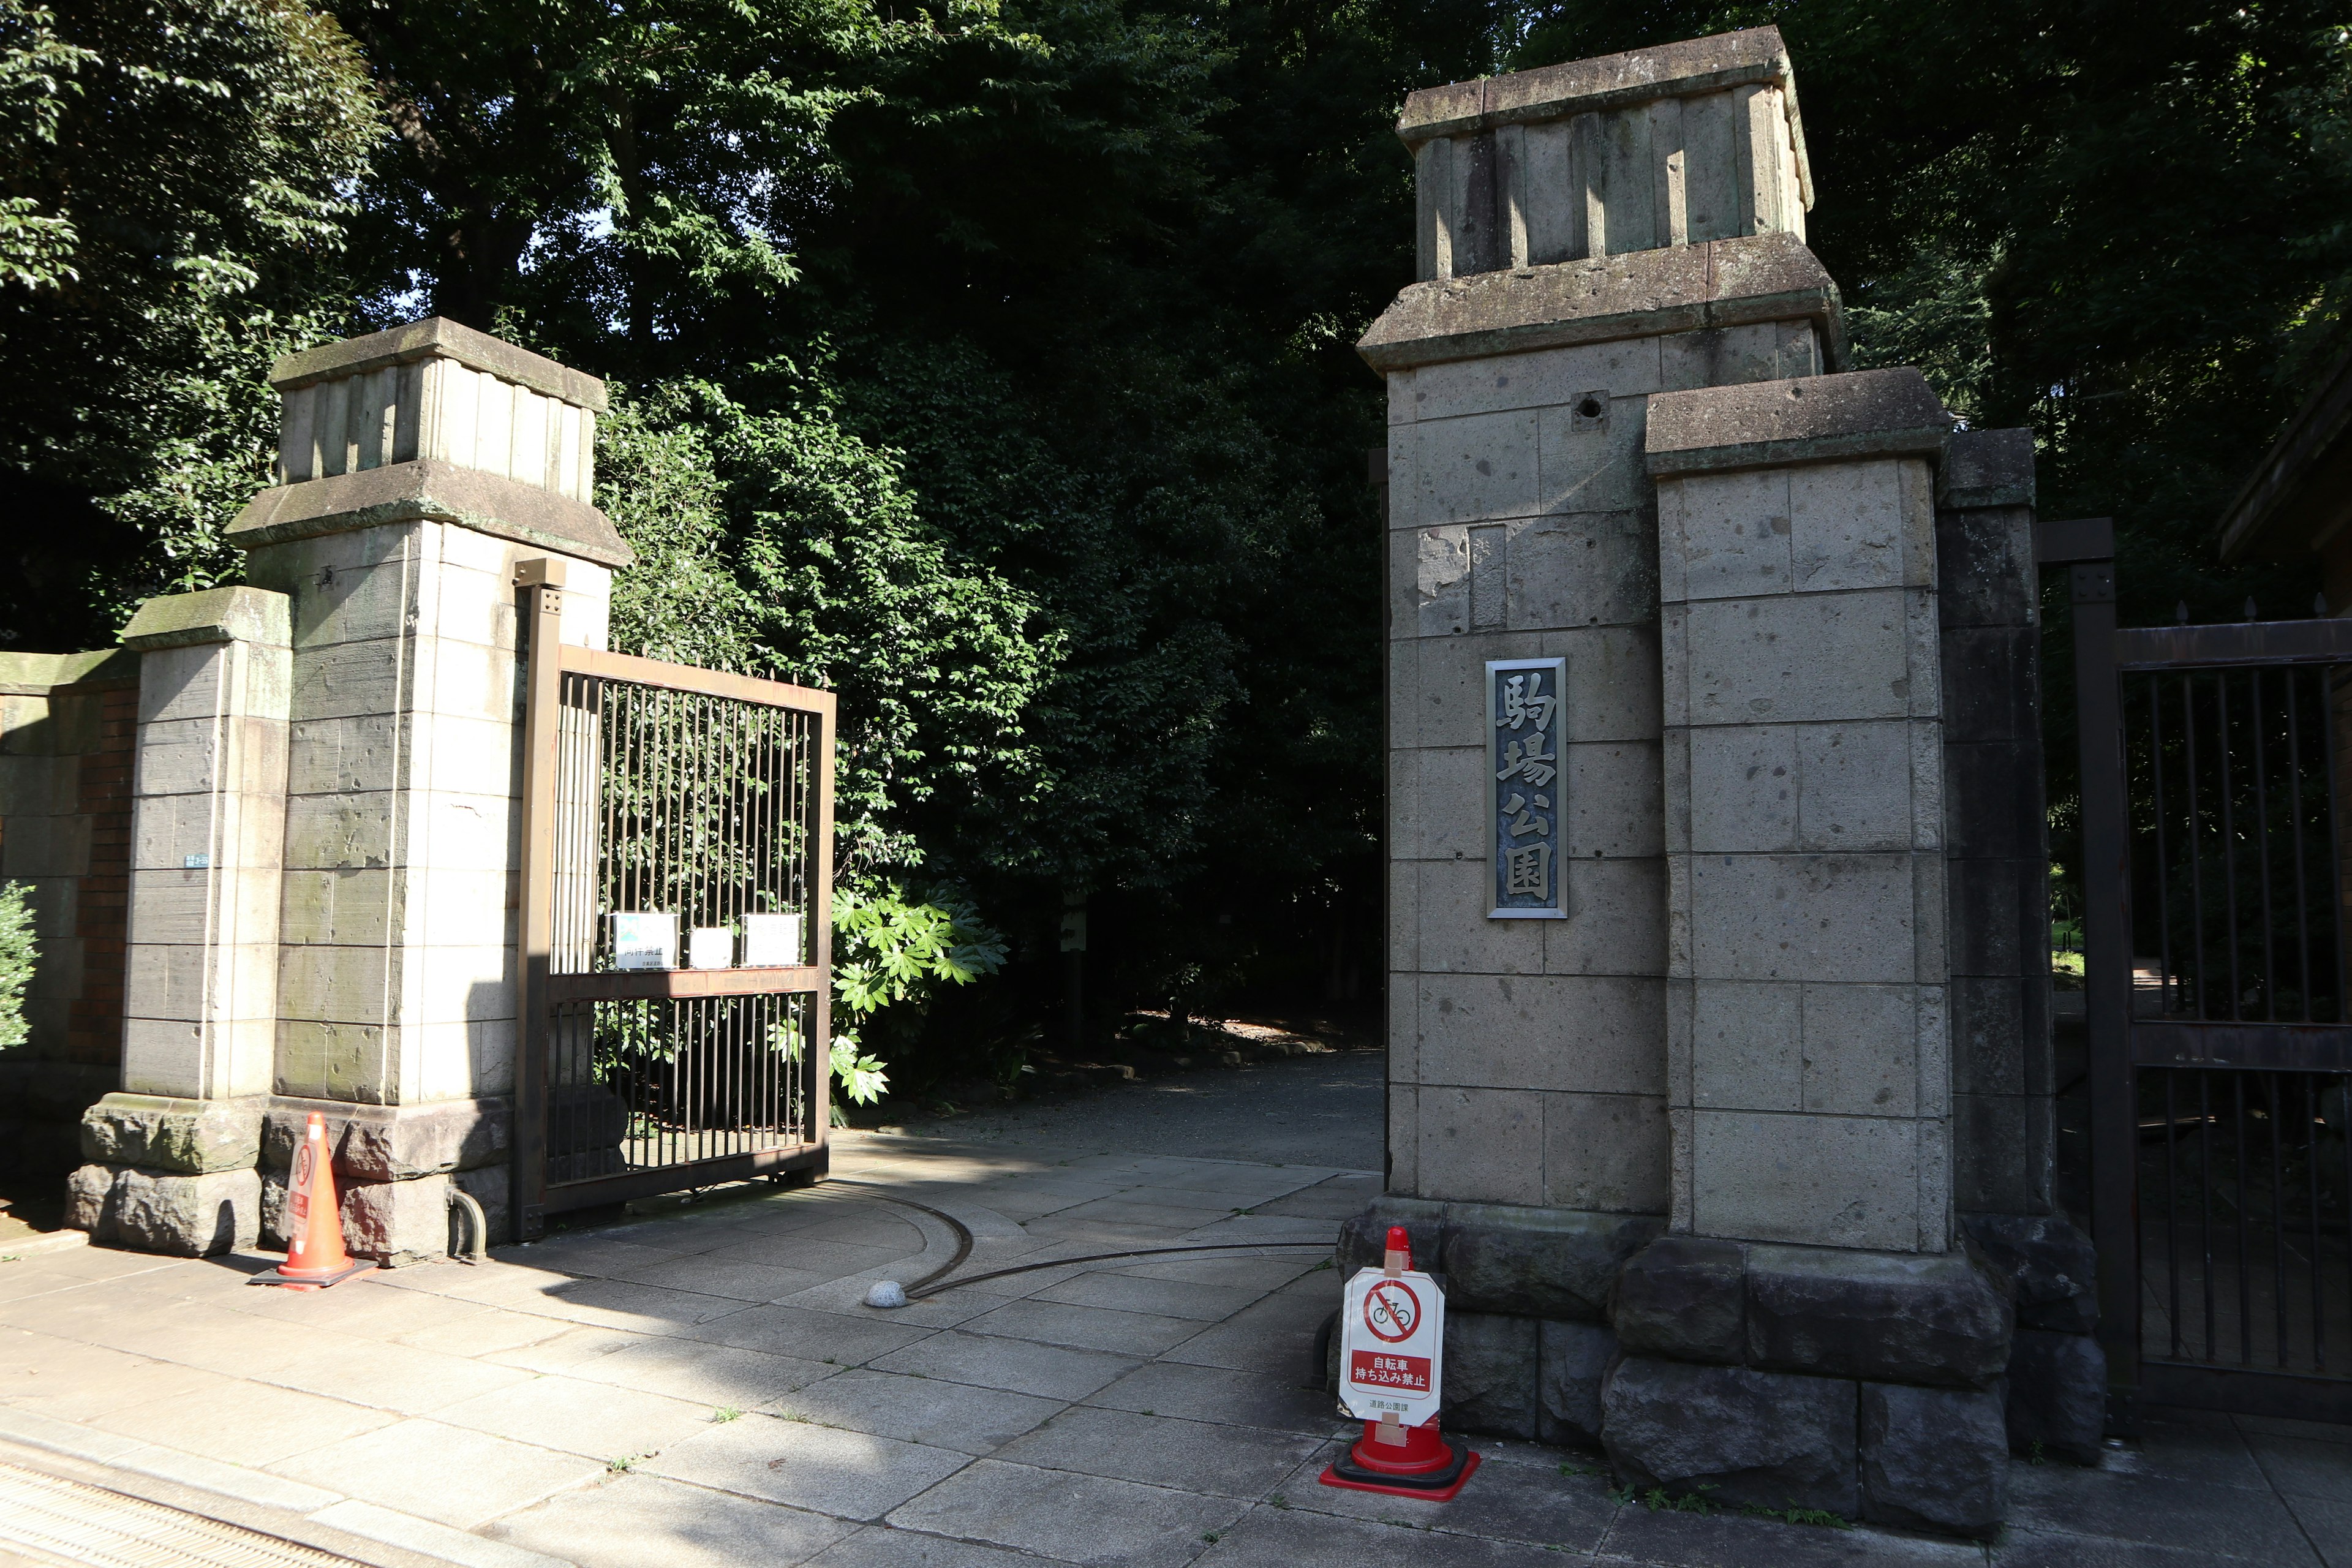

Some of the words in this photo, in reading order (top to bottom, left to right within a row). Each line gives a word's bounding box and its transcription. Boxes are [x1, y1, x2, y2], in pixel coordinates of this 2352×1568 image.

[1496, 672, 1557, 901] 駒場公園
[1374, 1356, 1409, 1372] 自転車
[1355, 1366, 1426, 1387] 持ち込み禁止
[1369, 1399, 1409, 1412] 道路公園課
